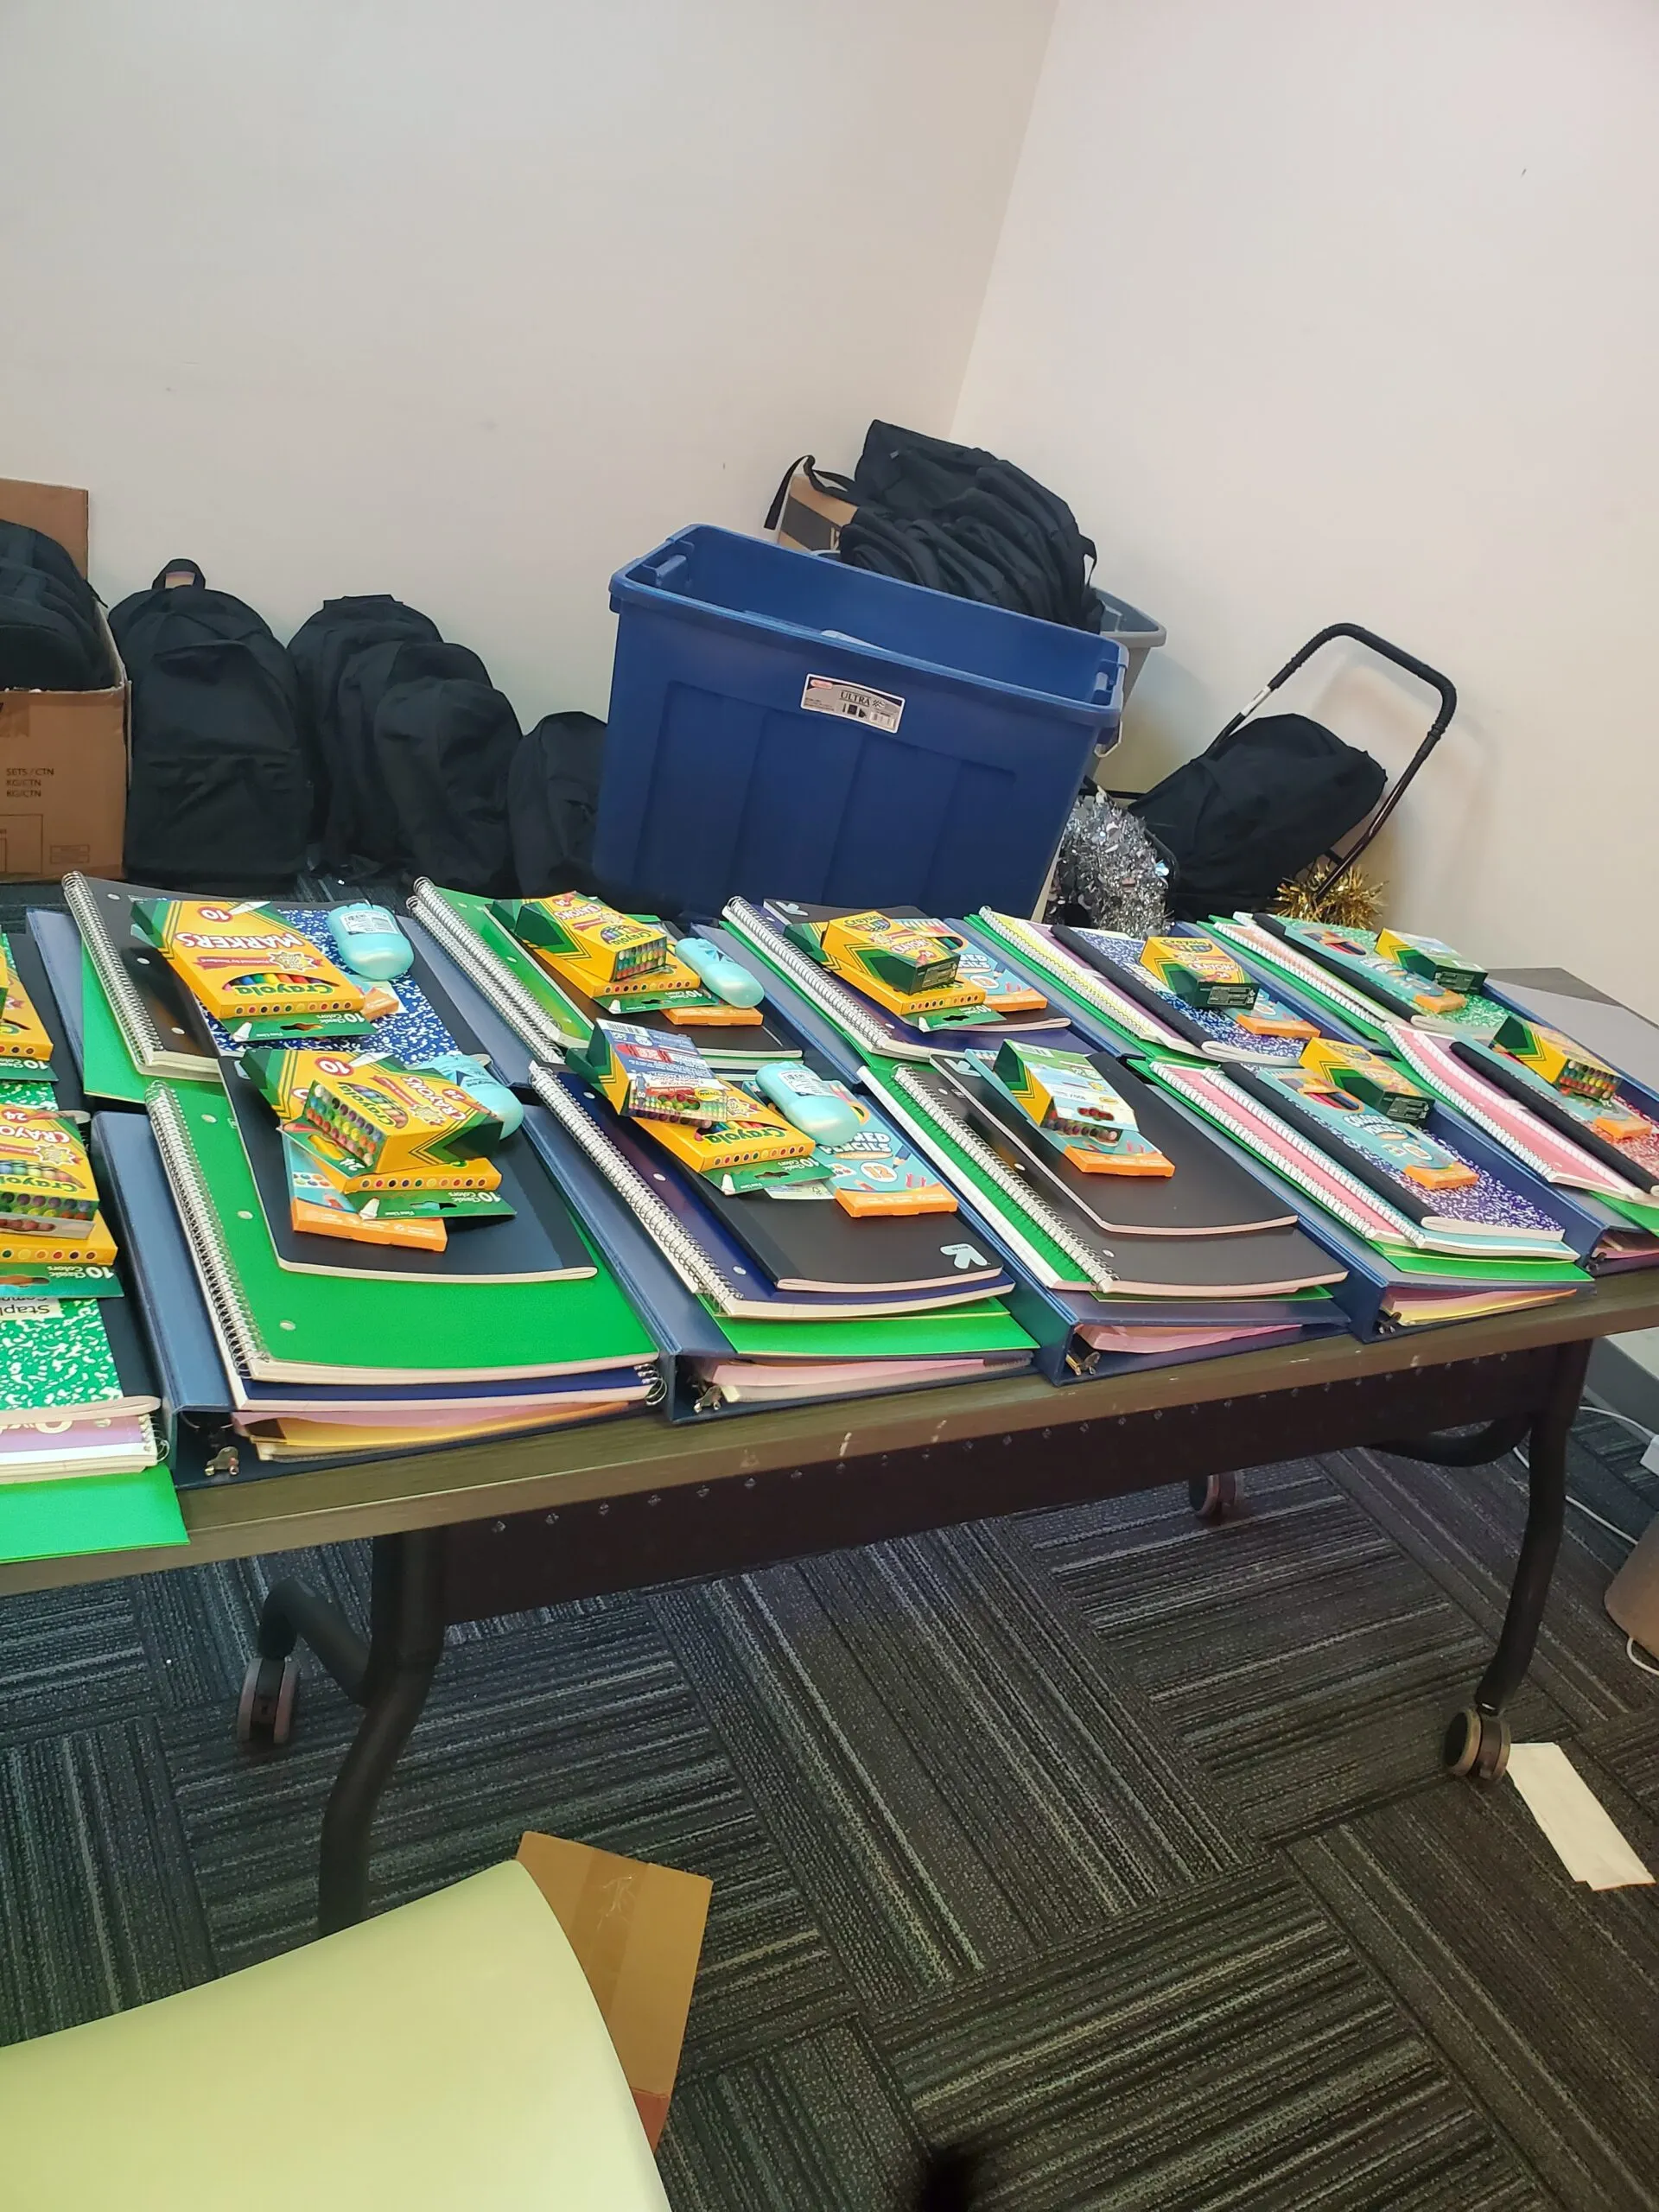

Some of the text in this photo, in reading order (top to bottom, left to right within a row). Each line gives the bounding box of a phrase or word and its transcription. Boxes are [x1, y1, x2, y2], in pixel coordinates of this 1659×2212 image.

[841, 691, 870, 706] ULTRA
[6, 767, 28, 776] SETS
[35, 767, 54, 776] CTN
[200, 910, 229, 921] 10
[554, 904, 601, 920] CRAYONS
[844, 916, 882, 927] Crayola
[175, 932, 304, 949] MARKERS
[609, 932, 652, 946] Crayola
[235, 984, 334, 996] Crayola
[343, 1013, 365, 1022] 10
[23, 1060, 48, 1070] 10
[320, 1060, 351, 1074] 10
[338, 1084, 397, 1126] Crayola
[401, 1077, 467, 1121] CRAYONS
[4, 1112, 28, 1121] 24
[704, 1128, 786, 1145] Crayola
[339, 1158, 365, 1172] 24
[799, 1158, 819, 1167] 10
[863, 1166, 895, 1179] 12
[478, 1192, 501, 1202] 10
[86, 1267, 114, 1279] 10
